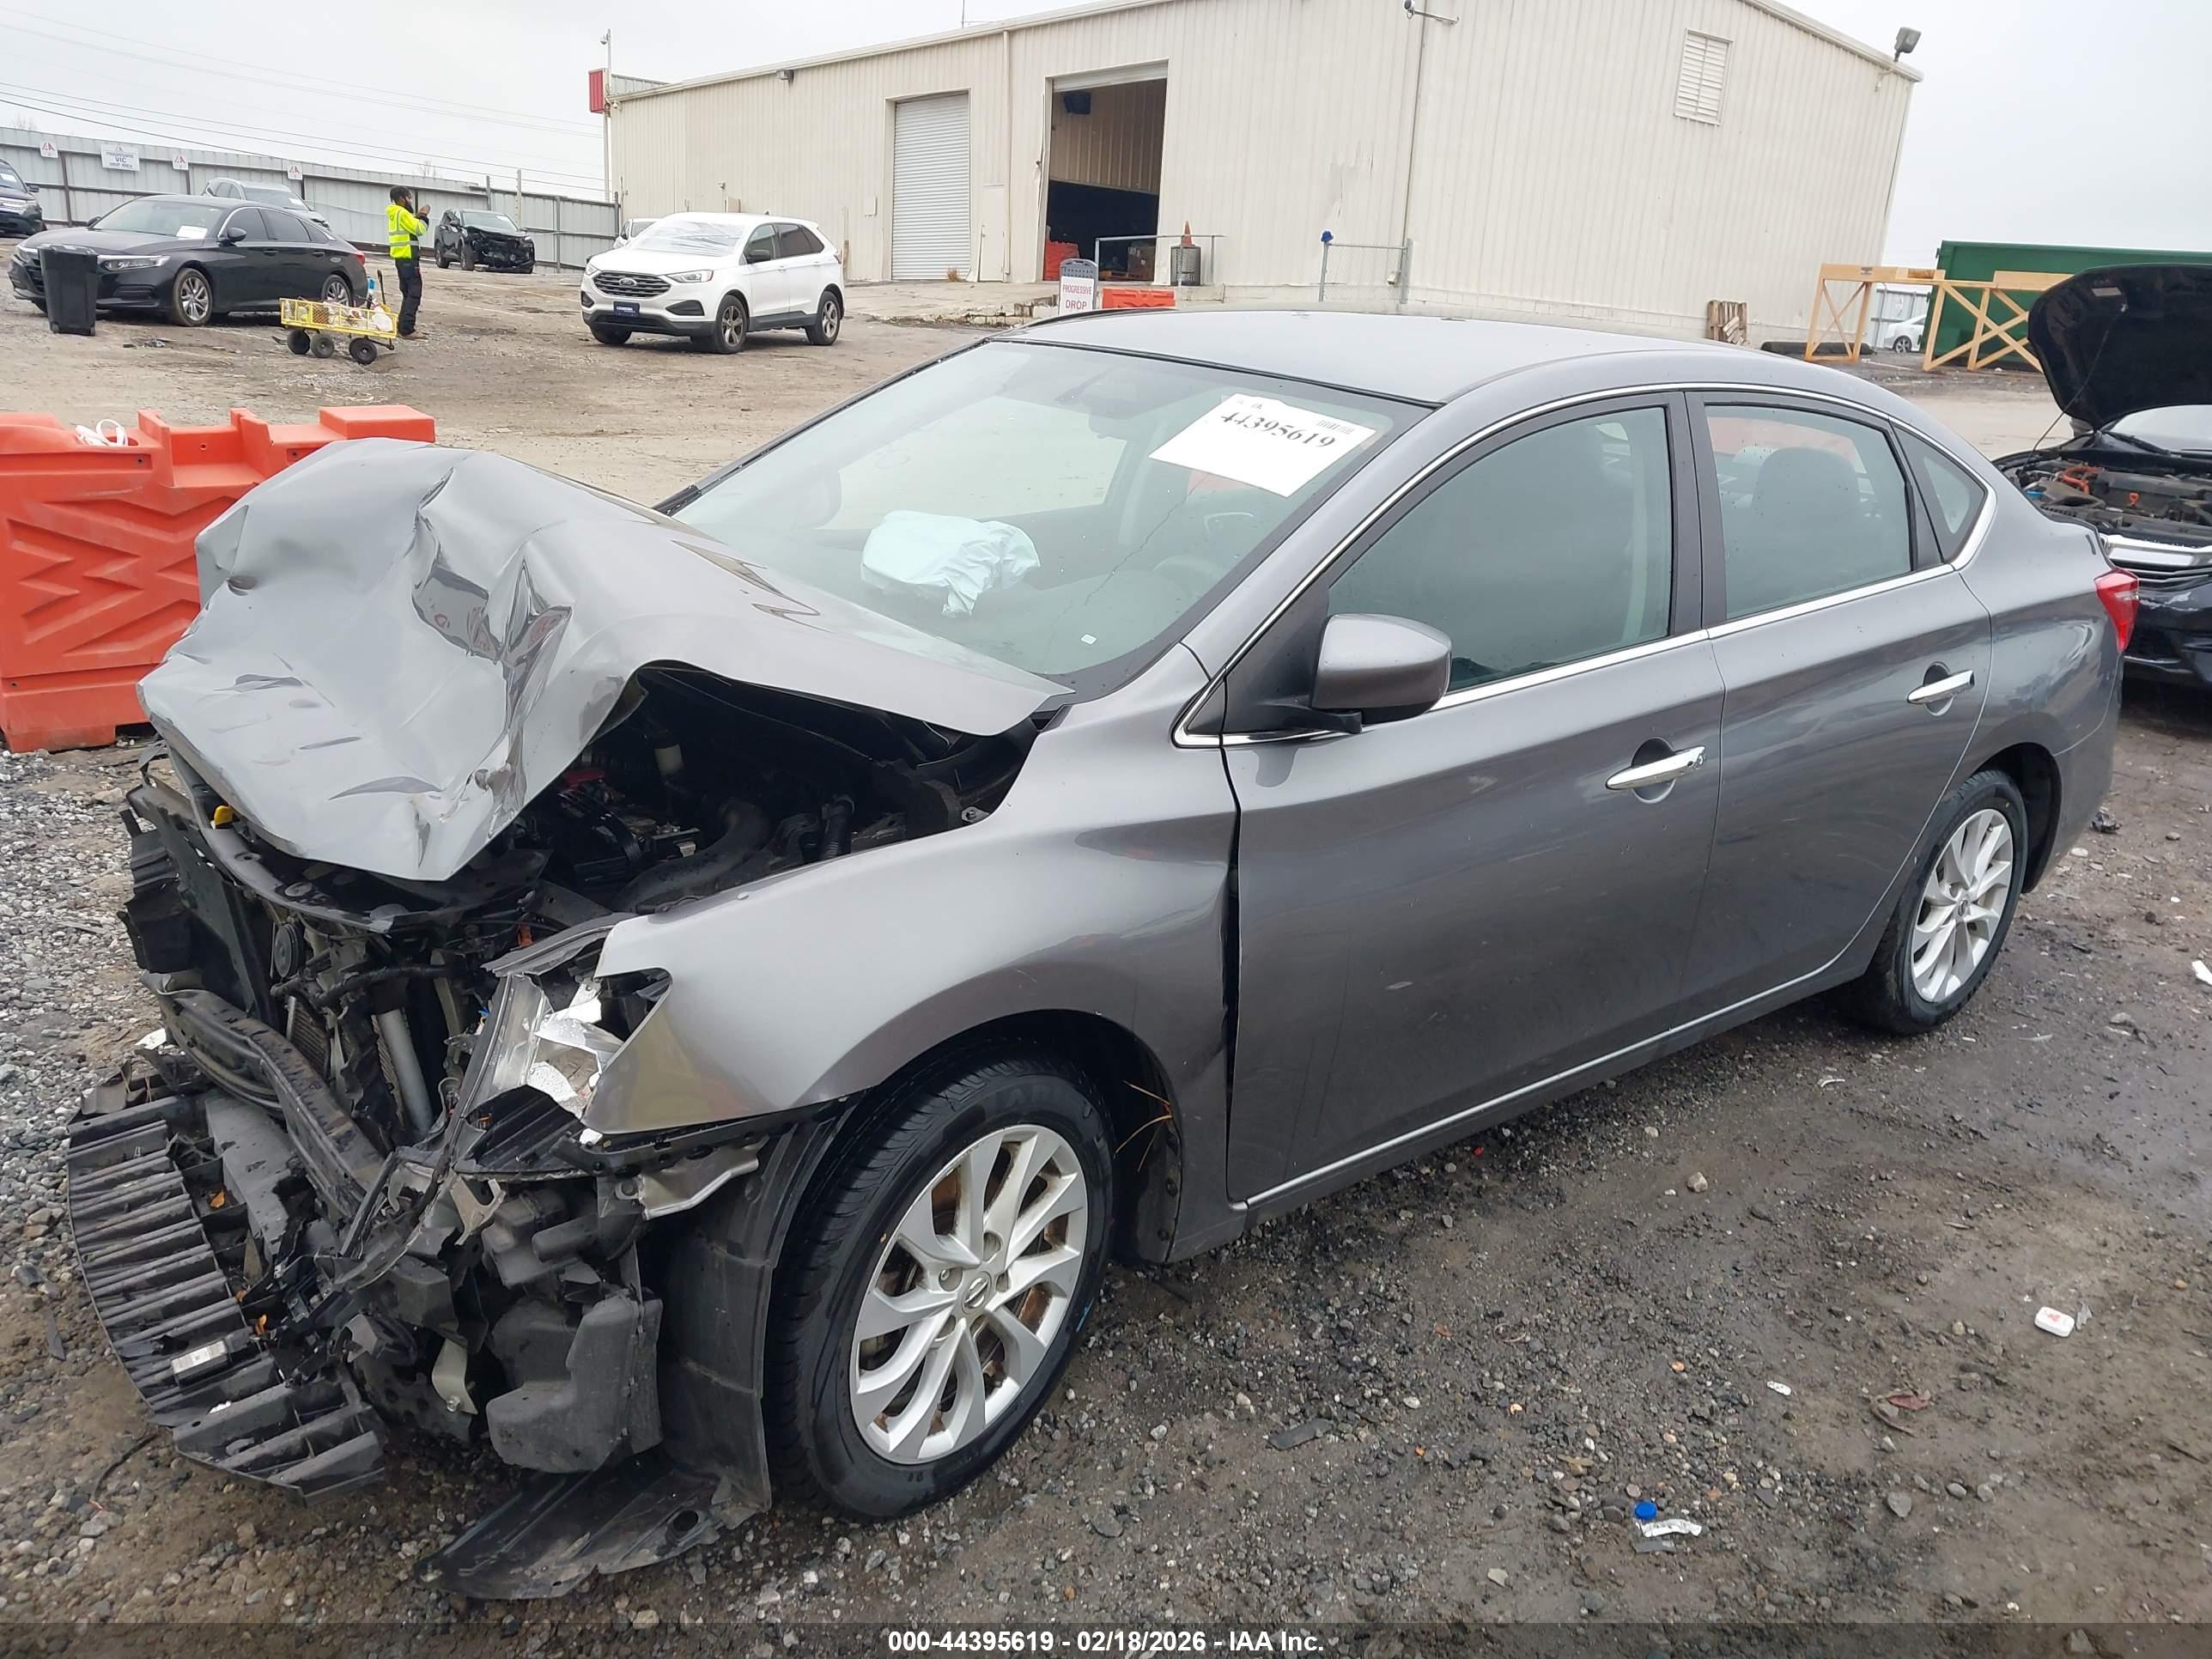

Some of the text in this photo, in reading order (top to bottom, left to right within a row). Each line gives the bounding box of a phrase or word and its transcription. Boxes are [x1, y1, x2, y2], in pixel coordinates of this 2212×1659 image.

[1062, 284, 1092, 295] PROGRESSIVE
[1065, 300, 1087, 310] DROP
[1220, 412, 1336, 447] 44395619
